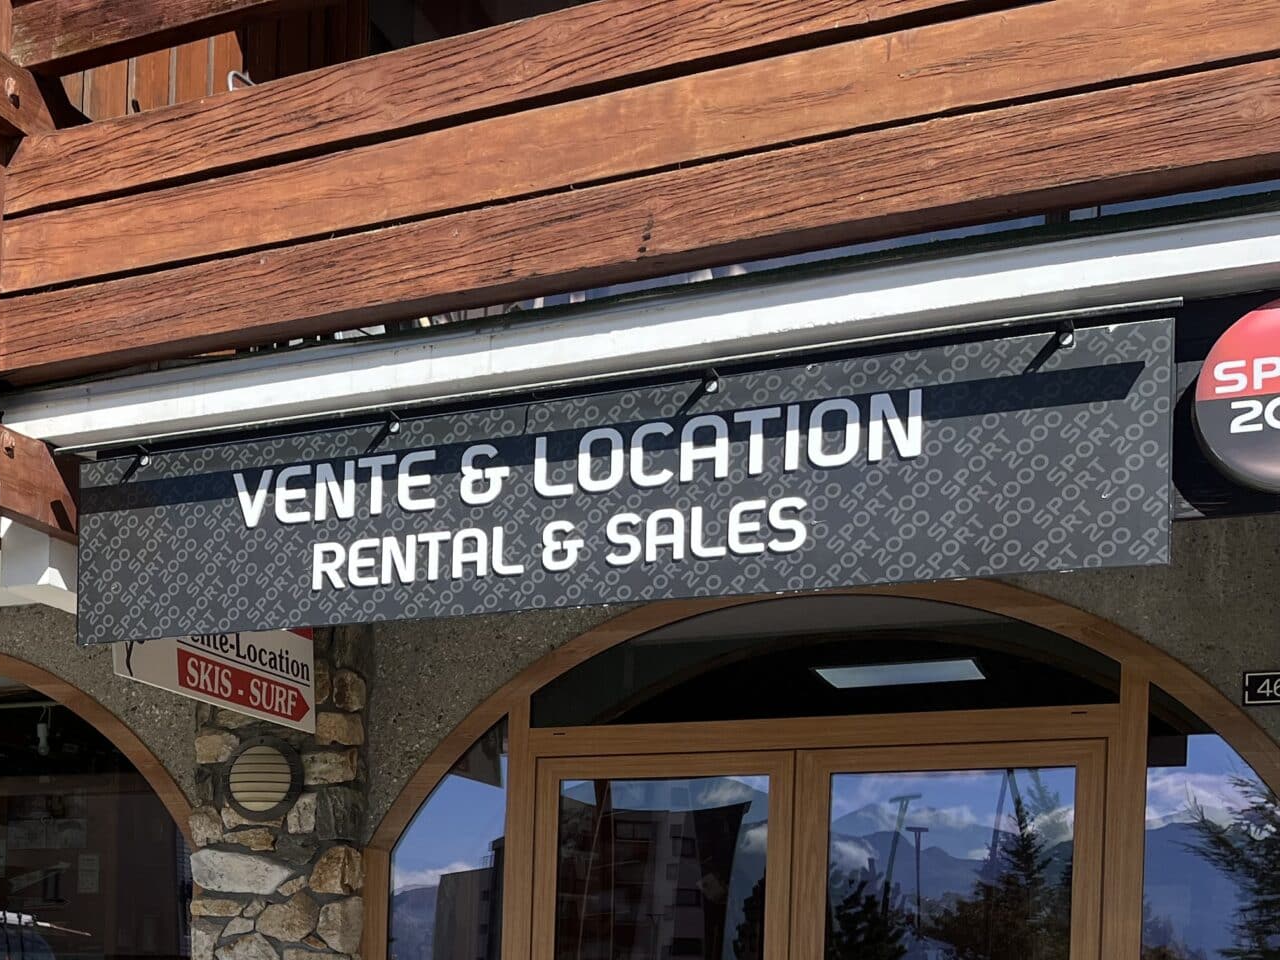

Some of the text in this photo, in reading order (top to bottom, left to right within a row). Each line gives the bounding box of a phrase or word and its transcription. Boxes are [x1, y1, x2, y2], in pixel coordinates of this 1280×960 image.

[233, 388, 923, 528] VENTE & LOCATION
[311, 497, 808, 592] RENTAL & SALES
[186, 657, 233, 698] SKIS
[249, 678, 298, 717] SURF
